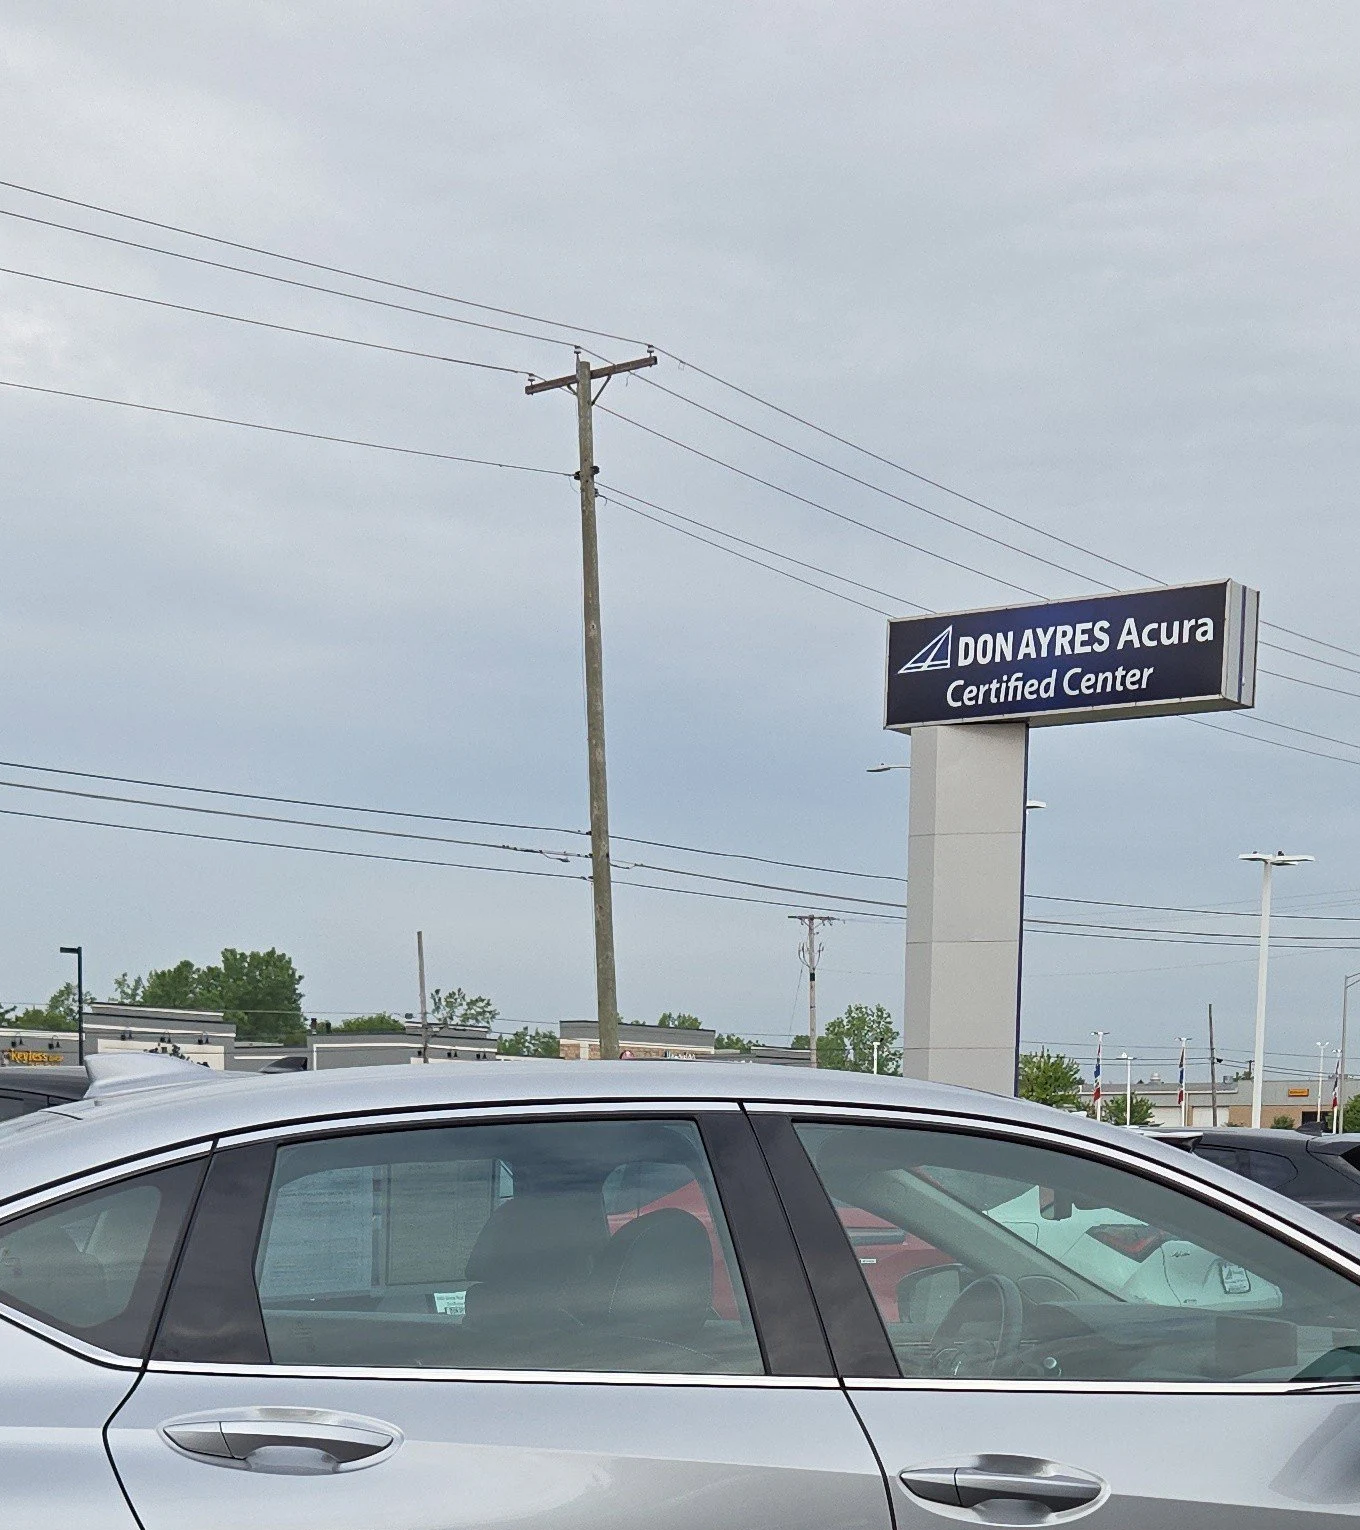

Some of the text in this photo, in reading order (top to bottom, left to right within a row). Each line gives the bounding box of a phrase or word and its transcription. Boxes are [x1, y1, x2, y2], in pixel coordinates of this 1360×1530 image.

[957, 616, 1215, 667] DON AYRES Acura
[946, 666, 1154, 708] Certified Center
